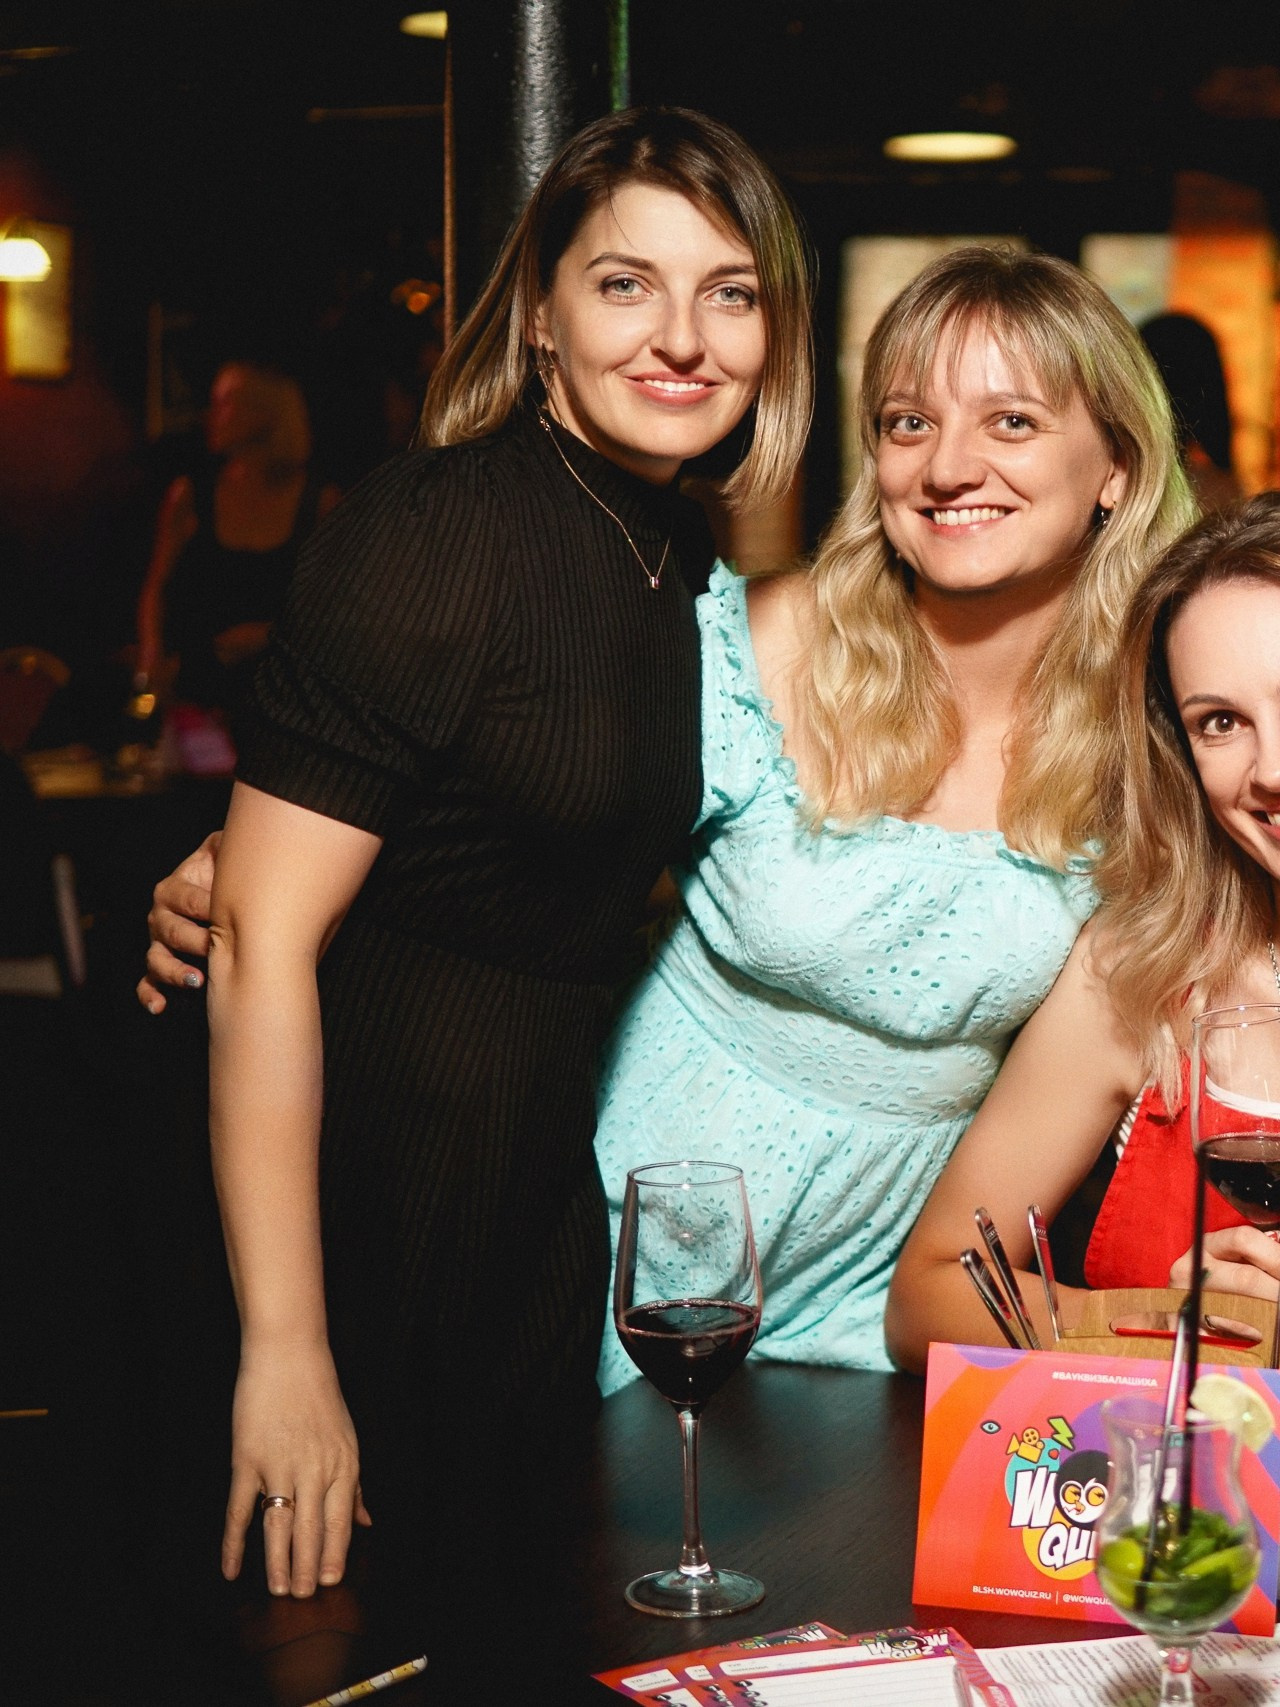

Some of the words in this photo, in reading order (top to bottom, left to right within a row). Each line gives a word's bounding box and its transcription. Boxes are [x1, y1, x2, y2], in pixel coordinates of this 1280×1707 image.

[1051, 1371, 1158, 1387] #ВАУКВИЗБАЛАШИХА
[1037, 1522, 1098, 1570] QUI
[972, 1585, 1052, 1600] BLSH.WOWQUIZ.RU
[890, 1645, 935, 1660] QUIZ
